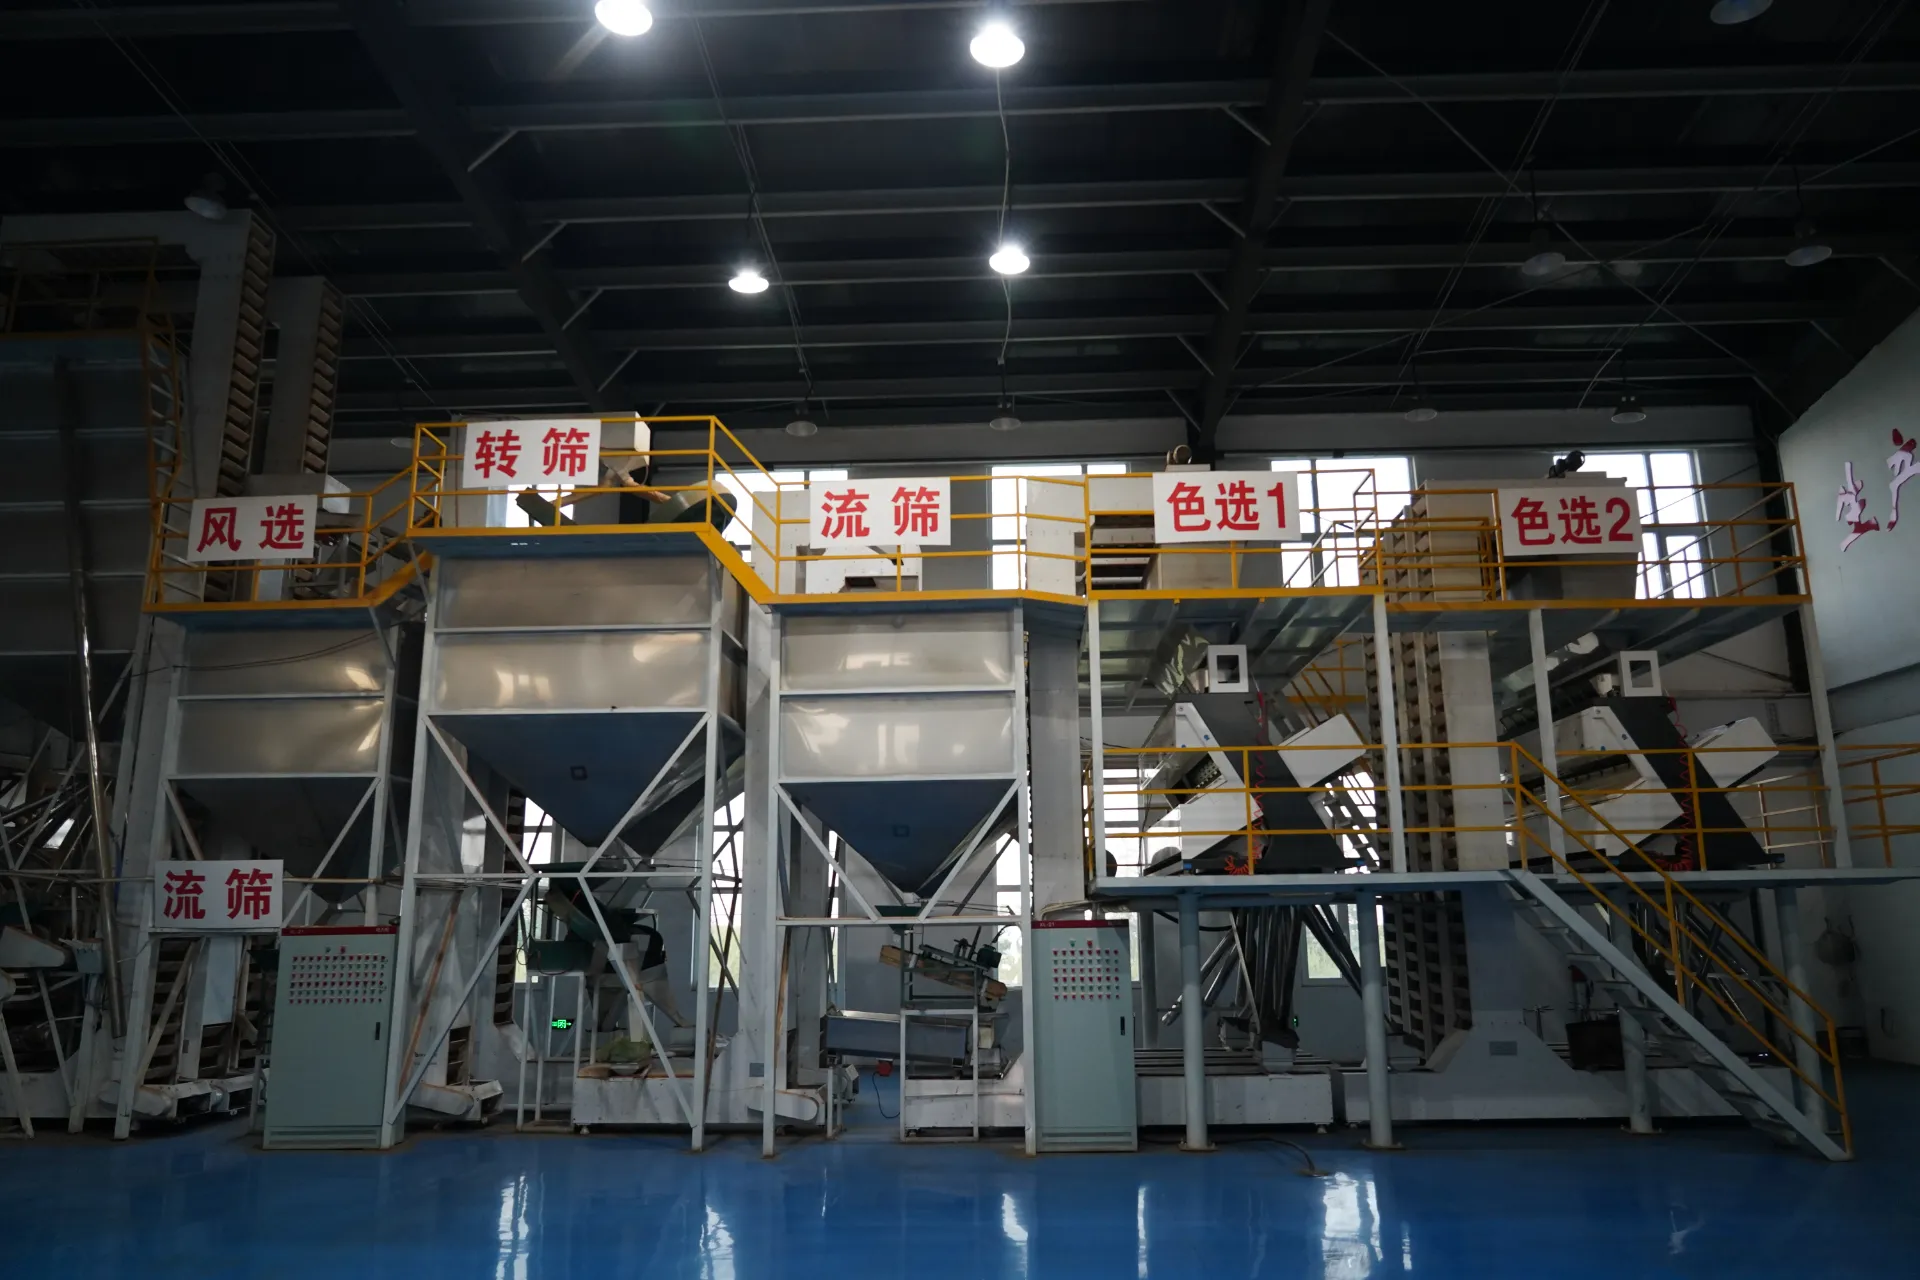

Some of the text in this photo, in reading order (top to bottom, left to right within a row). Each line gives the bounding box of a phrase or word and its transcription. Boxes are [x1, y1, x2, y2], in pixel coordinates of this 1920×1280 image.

[474, 427, 590, 479] 转筛
[196, 503, 304, 553] 风选
[821, 486, 940, 539] 流筛
[1167, 480, 1287, 532] 色选1
[1511, 495, 1634, 547] 色选2
[163, 868, 273, 920] 流筛
